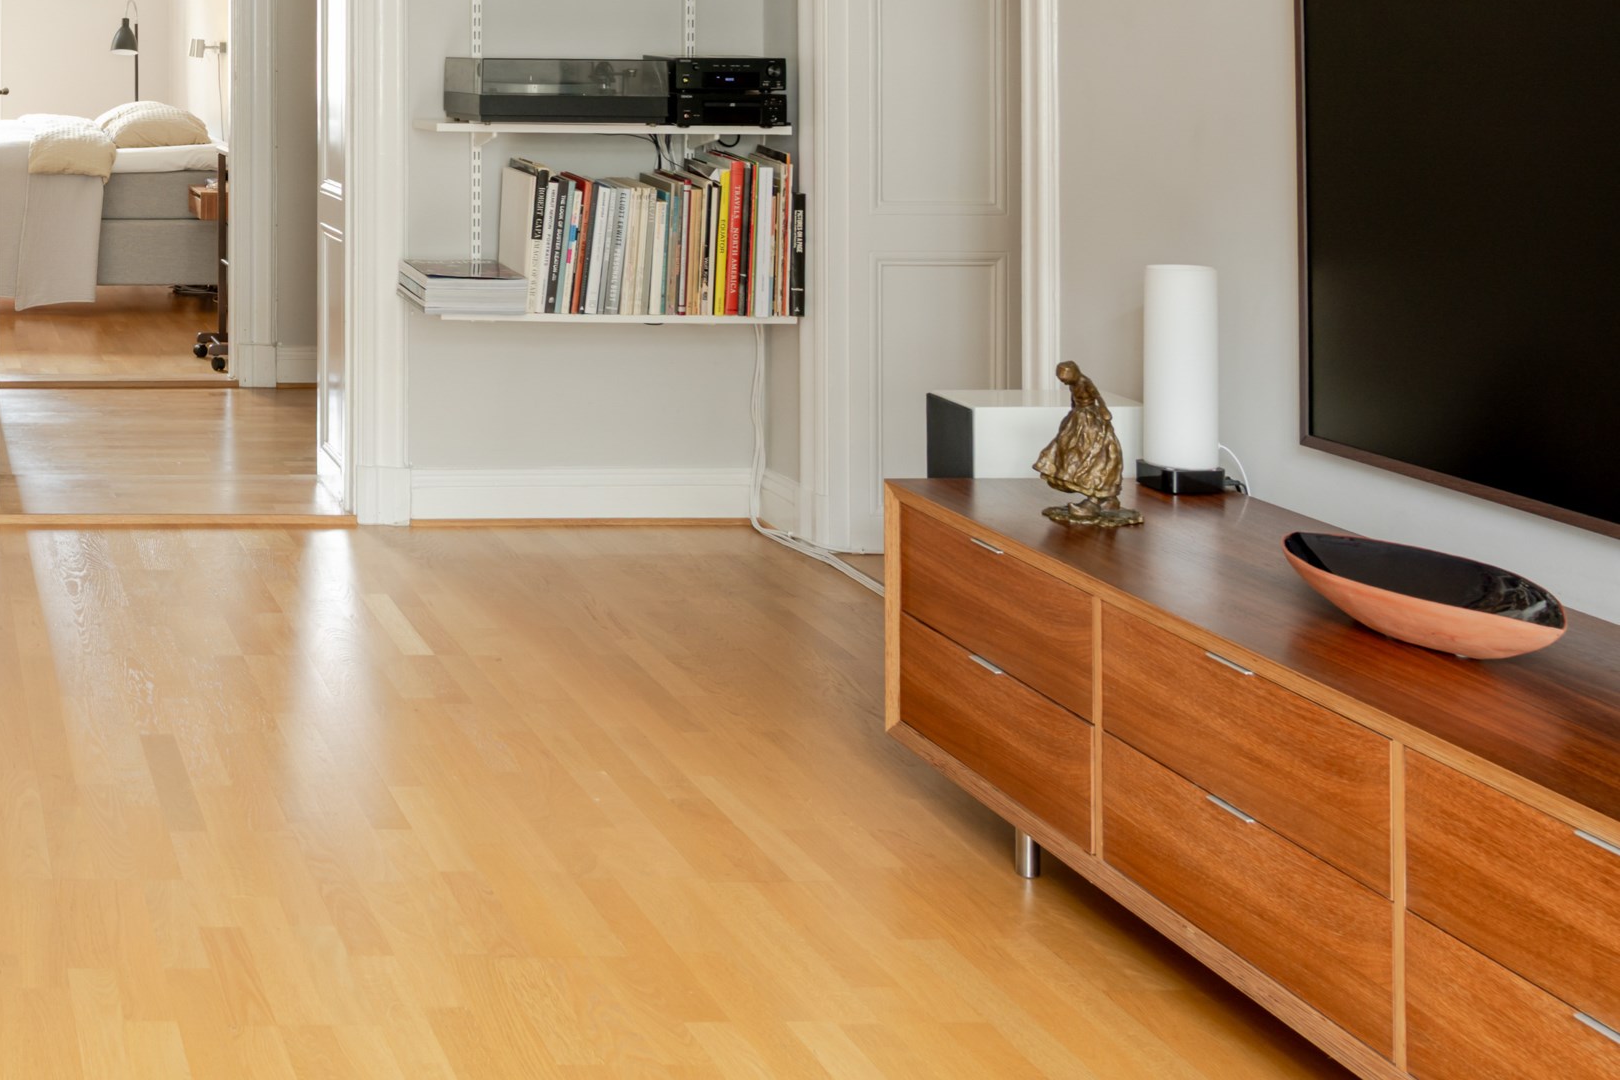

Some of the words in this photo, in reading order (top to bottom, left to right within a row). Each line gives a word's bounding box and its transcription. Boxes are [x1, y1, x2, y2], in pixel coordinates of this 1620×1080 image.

[536, 187, 546, 215] ROBERT
[615, 220, 624, 247] ERWITT
[552, 251, 562, 273] KEATON
[610, 248, 621, 283] PERSONAL
[730, 258, 739, 293] AMERICA
